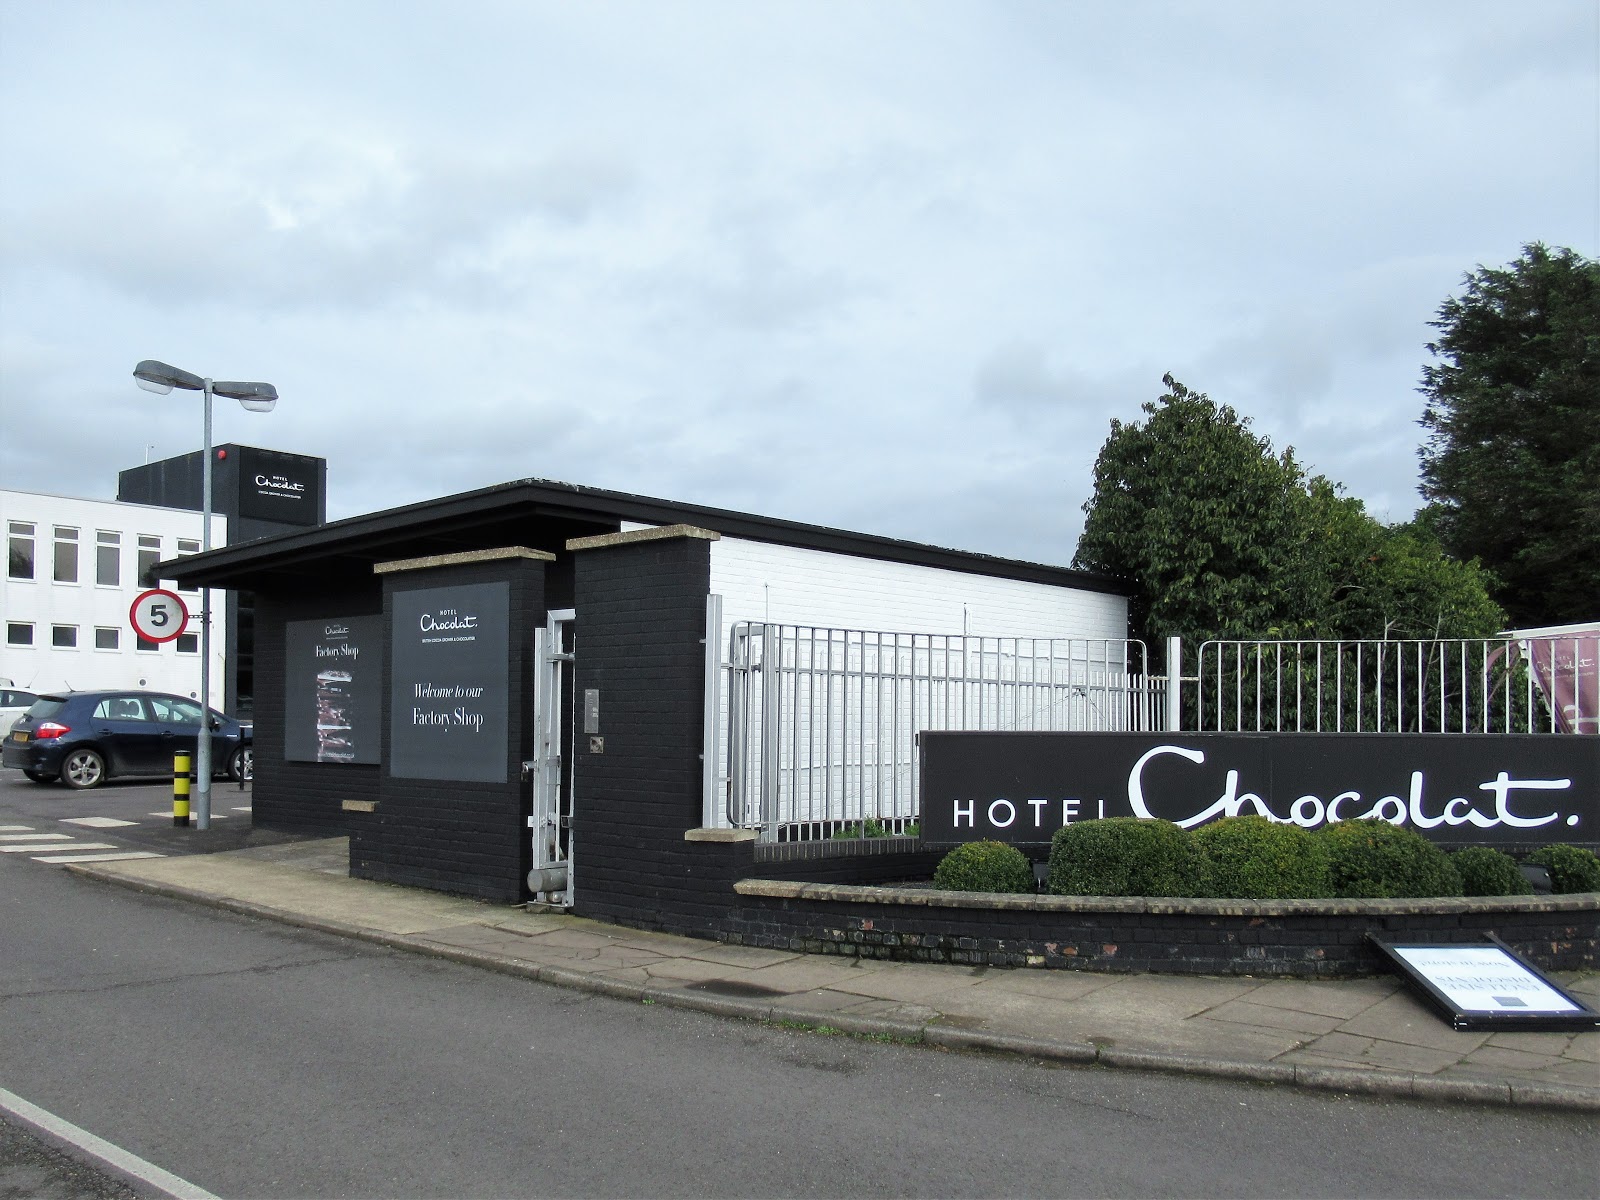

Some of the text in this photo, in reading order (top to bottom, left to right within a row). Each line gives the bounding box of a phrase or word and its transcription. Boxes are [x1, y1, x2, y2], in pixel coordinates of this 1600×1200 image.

[255, 475, 304, 491] Chocolat.
[150, 604, 169, 627] 5
[420, 614, 478, 632] Chocolat.
[316, 643, 359, 661] Factory Shop
[415, 683, 484, 699] Welcome to our
[413, 706, 484, 733] Factory Shop
